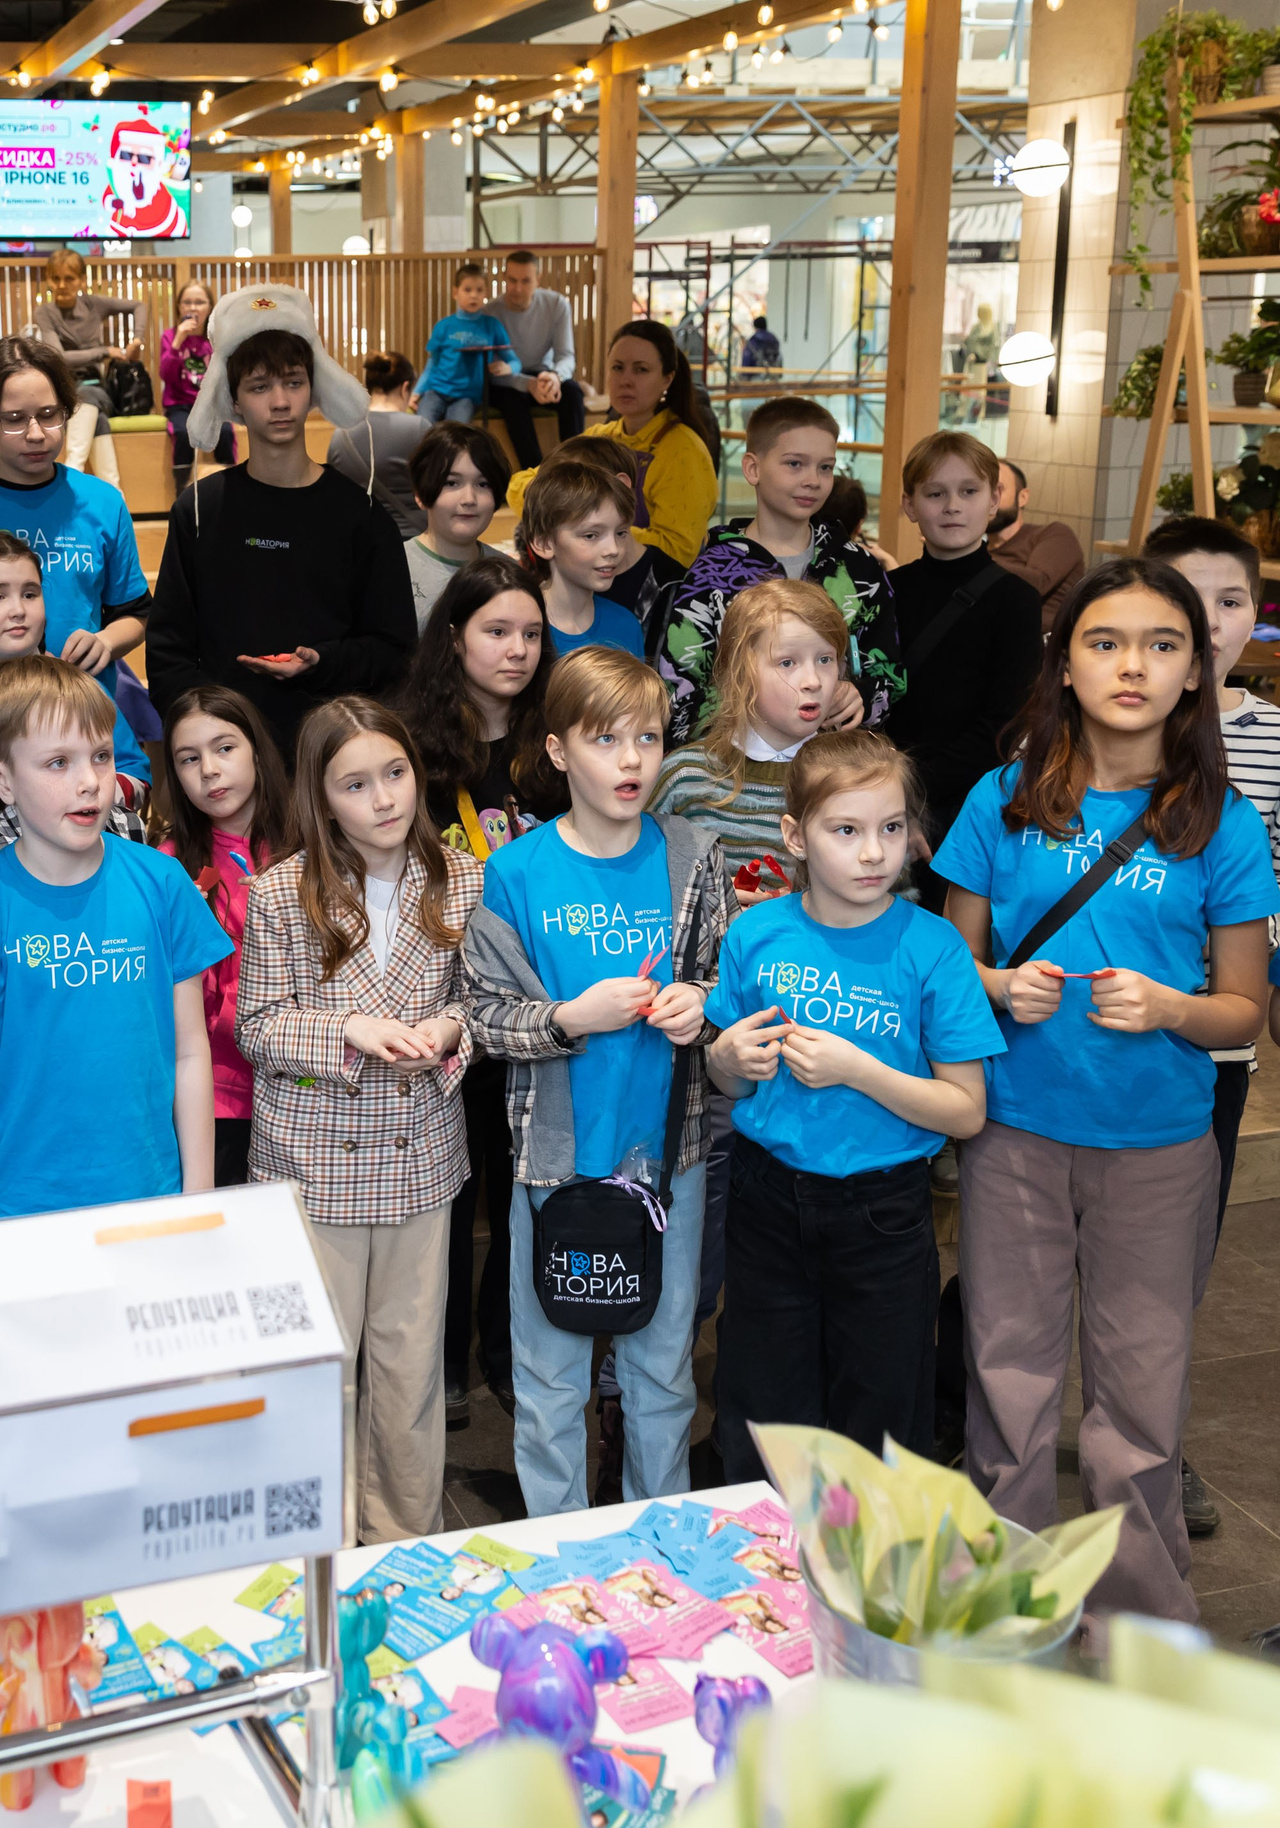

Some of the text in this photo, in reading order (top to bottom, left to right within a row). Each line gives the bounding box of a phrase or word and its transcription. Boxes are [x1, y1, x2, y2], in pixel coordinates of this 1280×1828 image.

[58, 152, 98, 166] -25%
[5, 172, 66, 185] IPHONE
[72, 172, 89, 185] 16
[634, 909, 661, 917] детская
[101, 938, 128, 946] детская
[101, 946, 146, 955] бизнес-школа
[44, 955, 146, 989] ТОРИЯ
[850, 985, 883, 996] детская
[790, 993, 901, 1038] ТОРИЯ
[552, 1275, 639, 1296] ТОРИЯ
[554, 1295, 640, 1305] детская бизнес-школа
[127, 1291, 239, 1332] РЕПУТАЦИЯ
[144, 1488, 255, 1534] РЕПУТАЦИЯ
